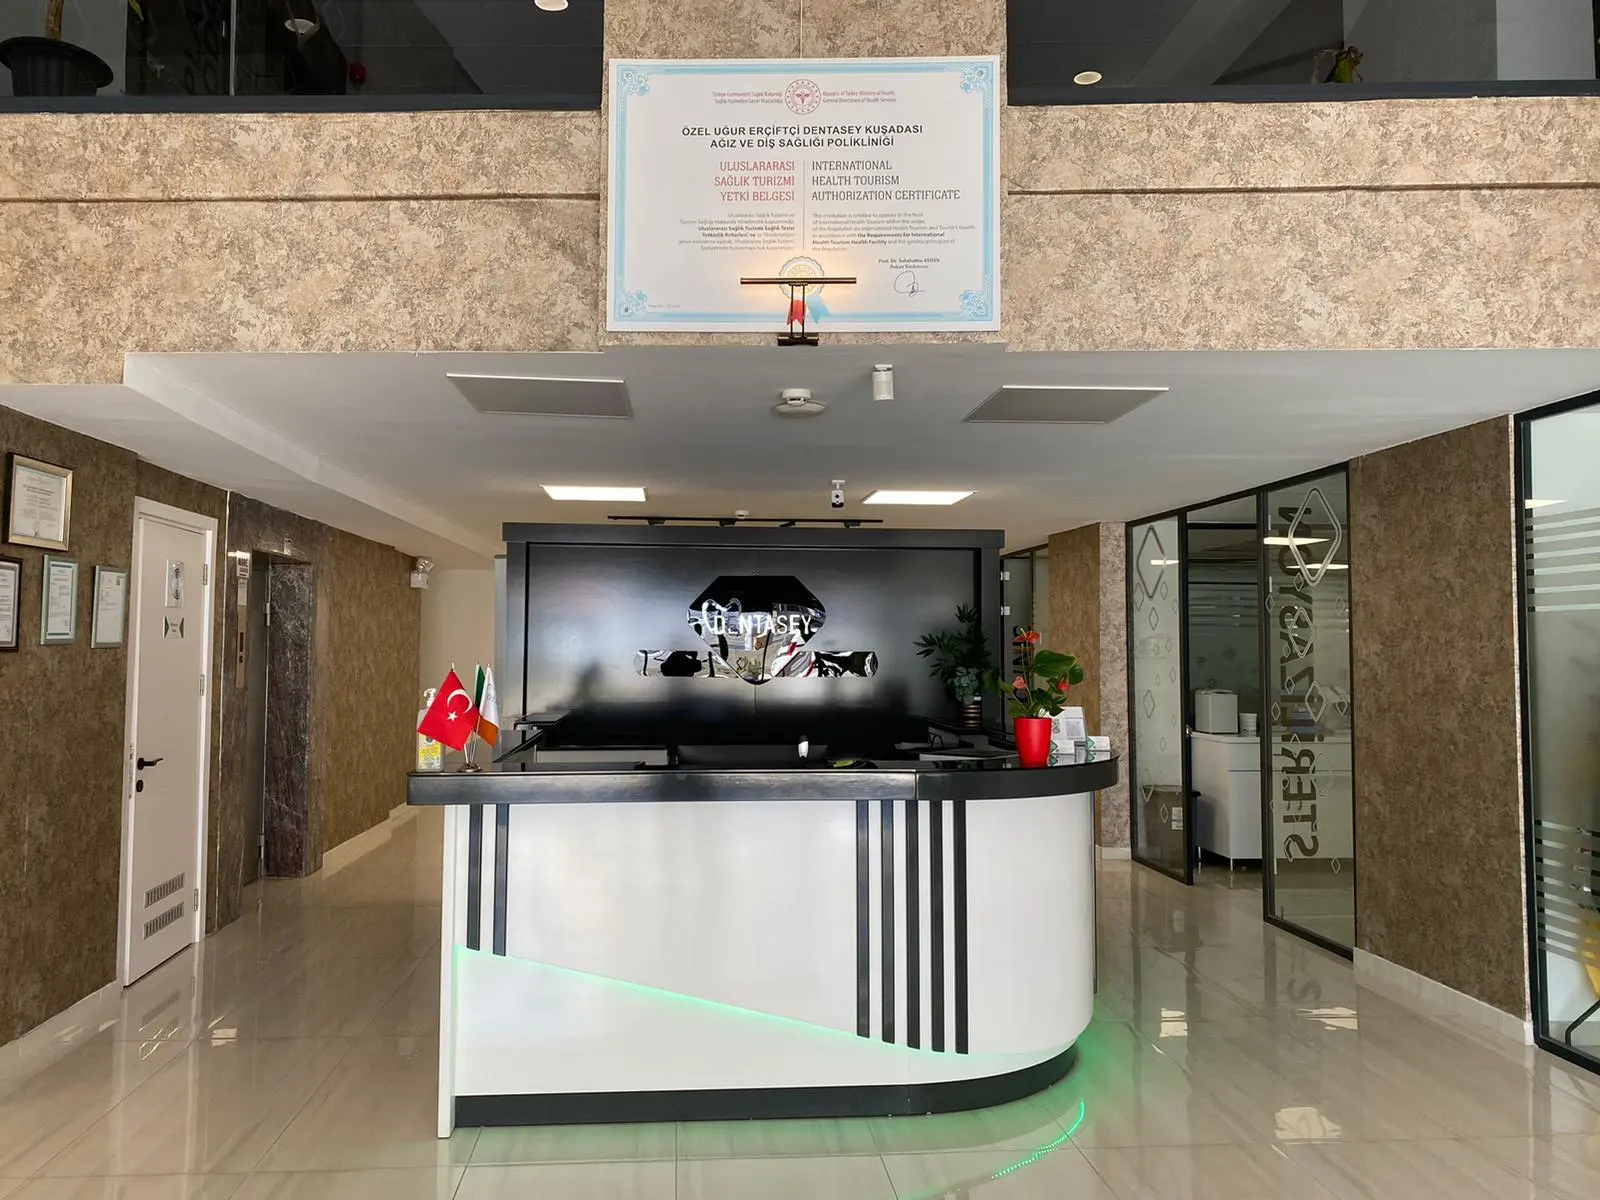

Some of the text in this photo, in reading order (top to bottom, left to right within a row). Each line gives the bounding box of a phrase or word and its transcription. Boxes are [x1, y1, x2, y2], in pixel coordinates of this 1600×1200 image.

[681, 124, 923, 137] ÖZEL UĞUR ERÇİFTÇİ DENTASEY KUŞADASI
[710, 136, 894, 149] AĞIZ VE DİŞ SAĞLIĞI POLİKLİNİĞİ
[720, 161, 795, 171] ULUSLARARASI
[812, 160, 893, 171] INTERNATIONAL
[714, 175, 750, 187] SAĞLIK
[812, 175, 900, 186] HEALTH TOURISM
[720, 190, 795, 201] YETKİ BELGESİ
[812, 189, 961, 201] AUTHORIZATION CERTIFICATE
